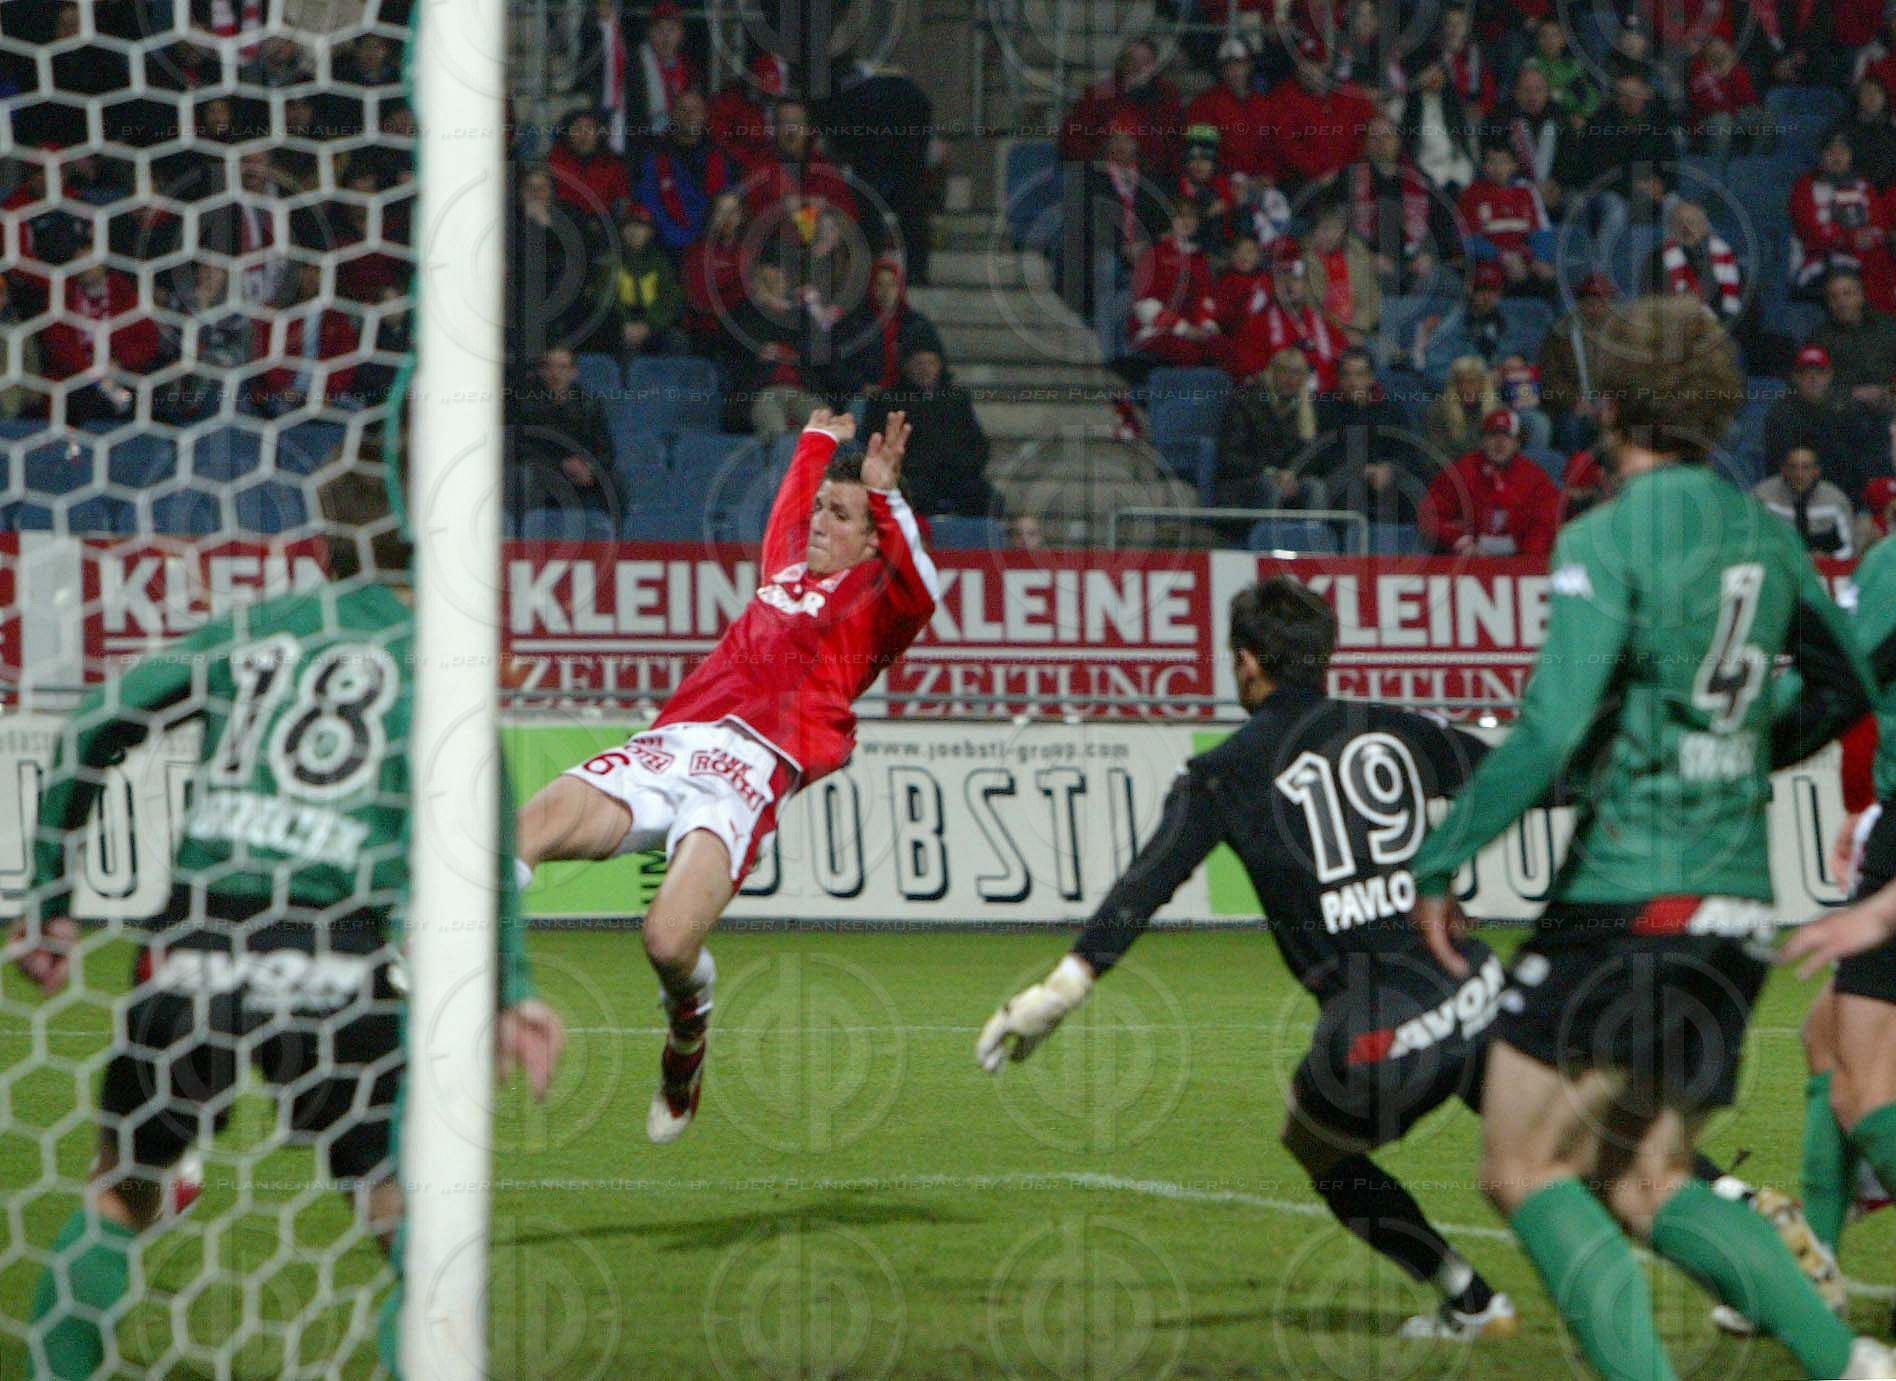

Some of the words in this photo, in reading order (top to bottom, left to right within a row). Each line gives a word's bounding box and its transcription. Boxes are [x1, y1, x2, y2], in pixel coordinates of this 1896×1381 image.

[99, 555, 331, 632] KLEI
[509, 560, 756, 634] KLEIN
[1692, 562, 1765, 735] 4
[207, 632, 400, 803] 18
[1274, 731, 1426, 883] 19
